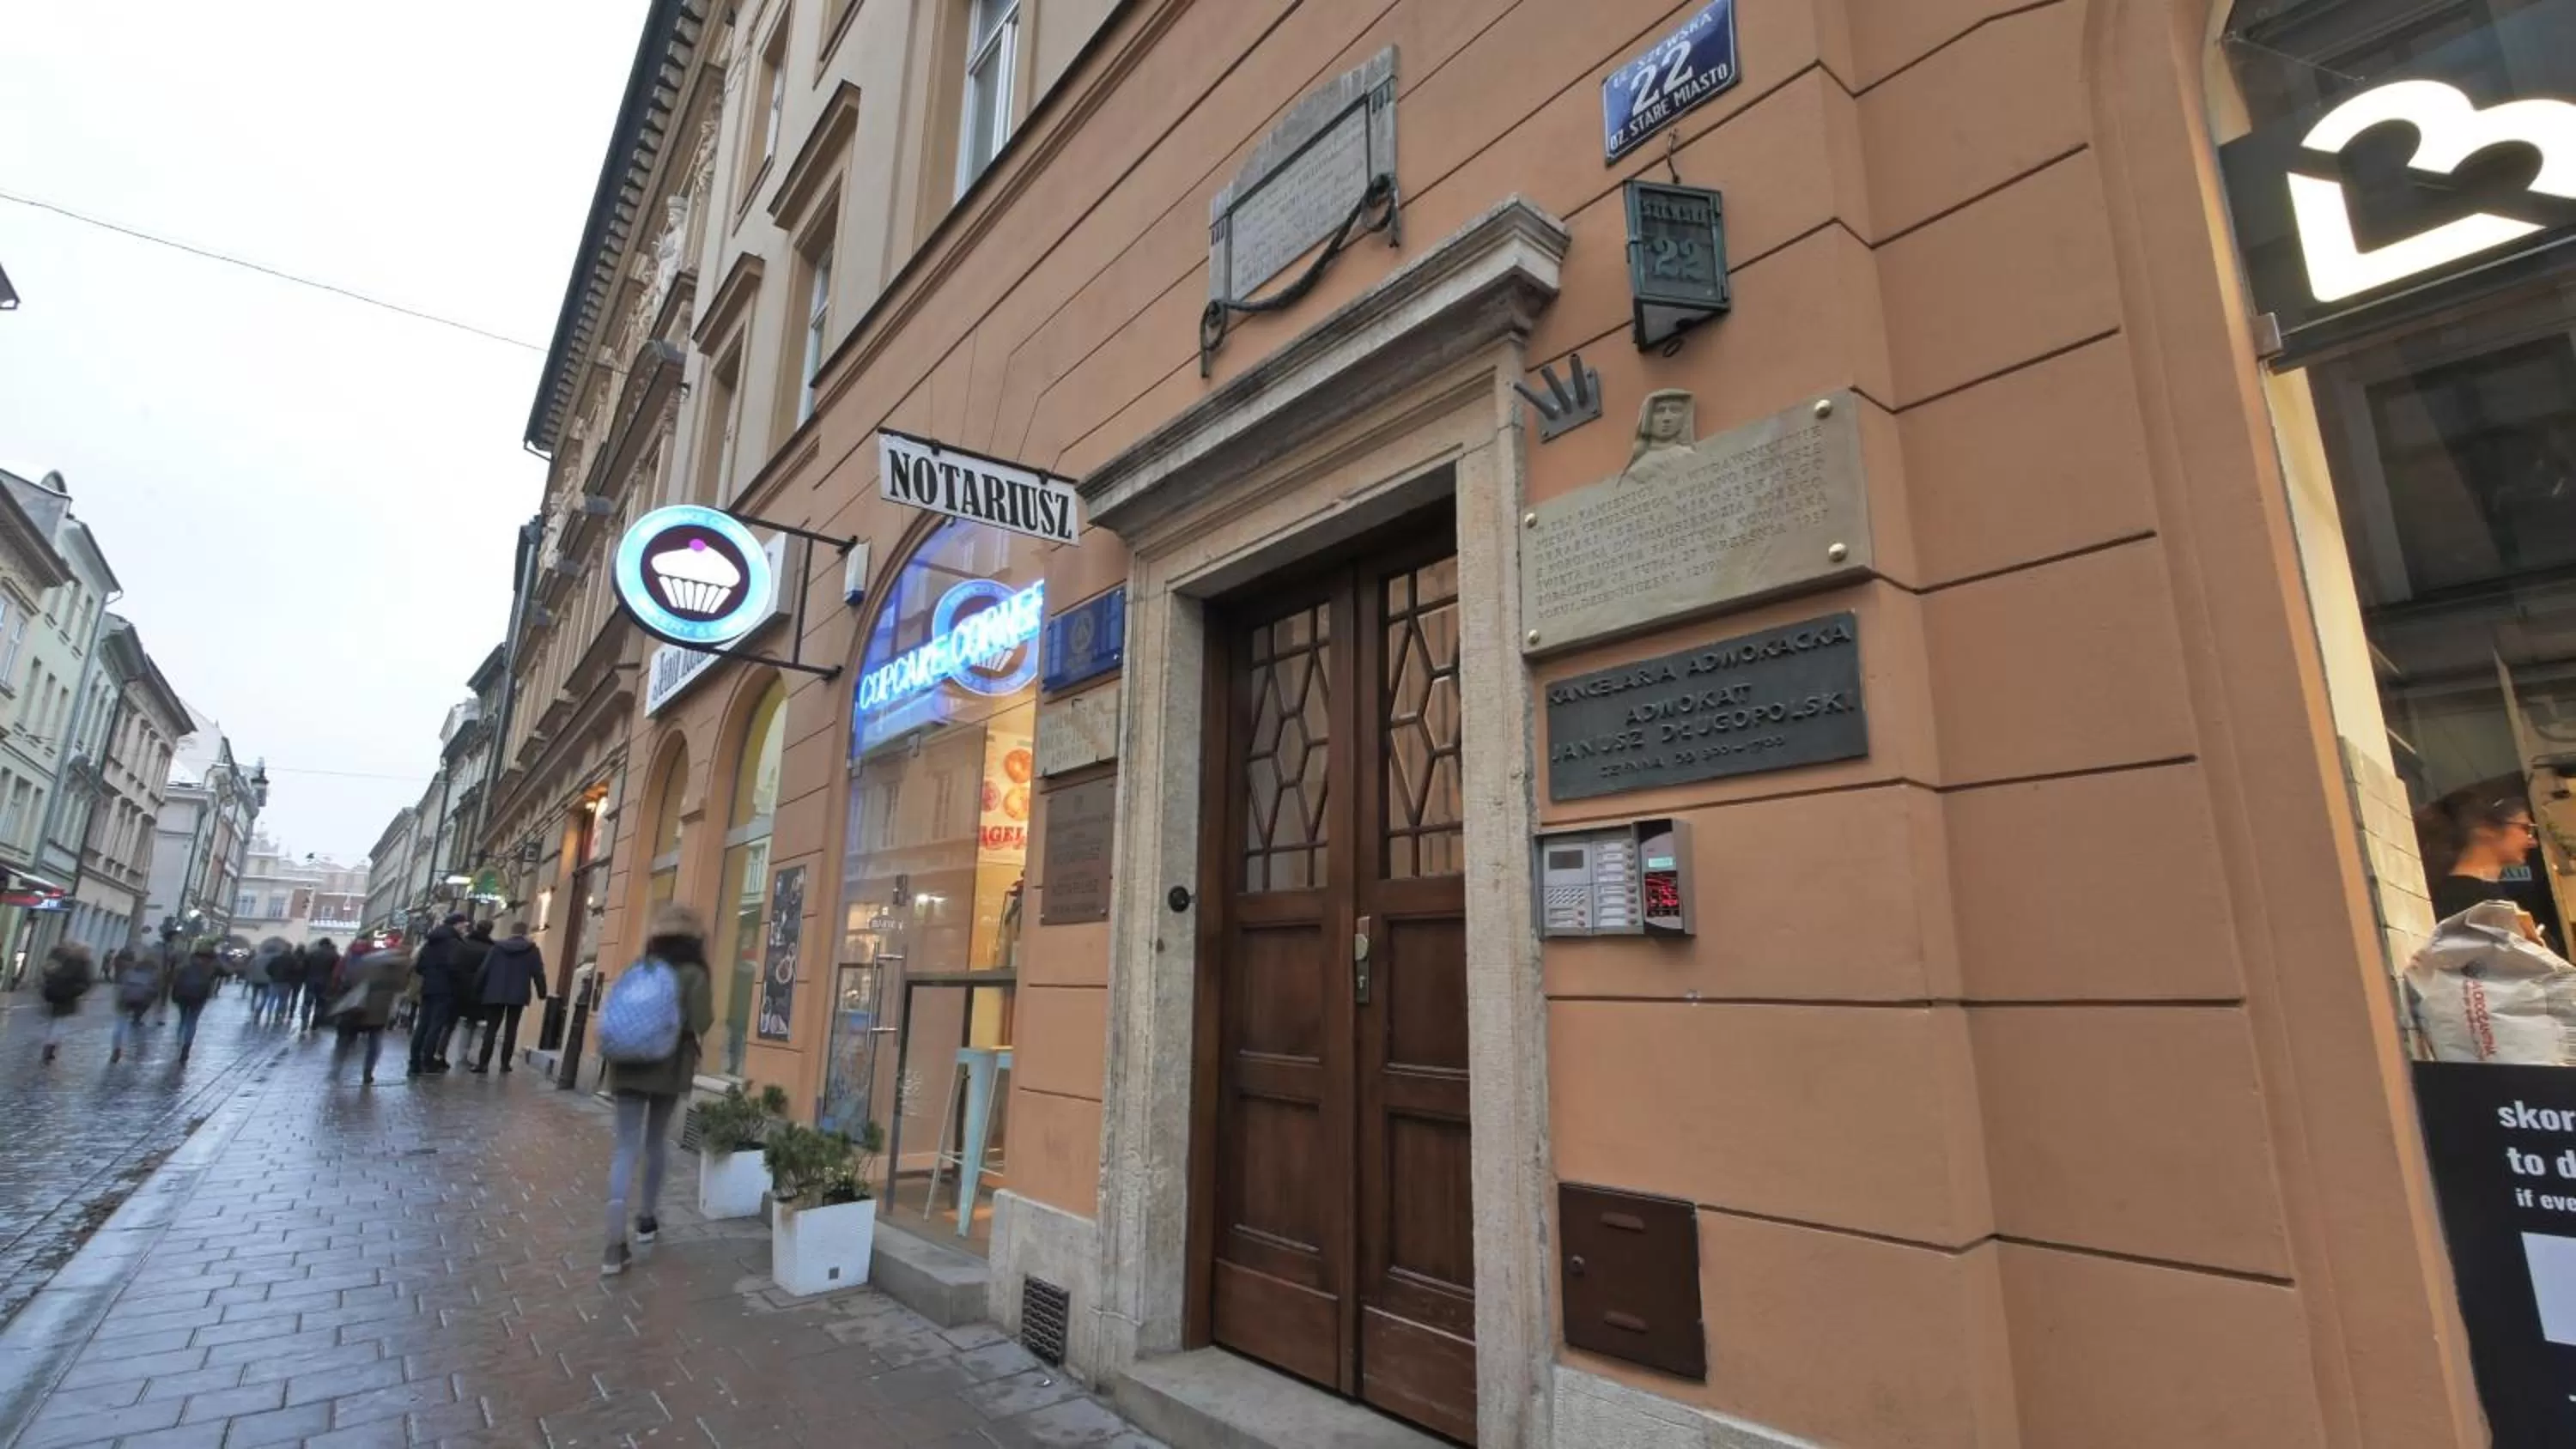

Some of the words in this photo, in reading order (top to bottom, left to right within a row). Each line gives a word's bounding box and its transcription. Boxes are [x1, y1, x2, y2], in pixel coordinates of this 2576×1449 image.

[1630, 101, 1670, 136] STARE
[1674, 62, 1728, 112] MIASTO
[1631, 40, 1693, 116] 22
[888, 449, 1072, 539] NOTARIUSZ
[860, 634, 952, 710] CUPCAKE
[1686, 622, 1852, 679] ADWOKACKA
[1625, 682, 1753, 726] ADWOKAT
[2497, 1100, 2576, 1132] skor
[2506, 1147, 2546, 1176] to
[2514, 1187, 2534, 1208] if
